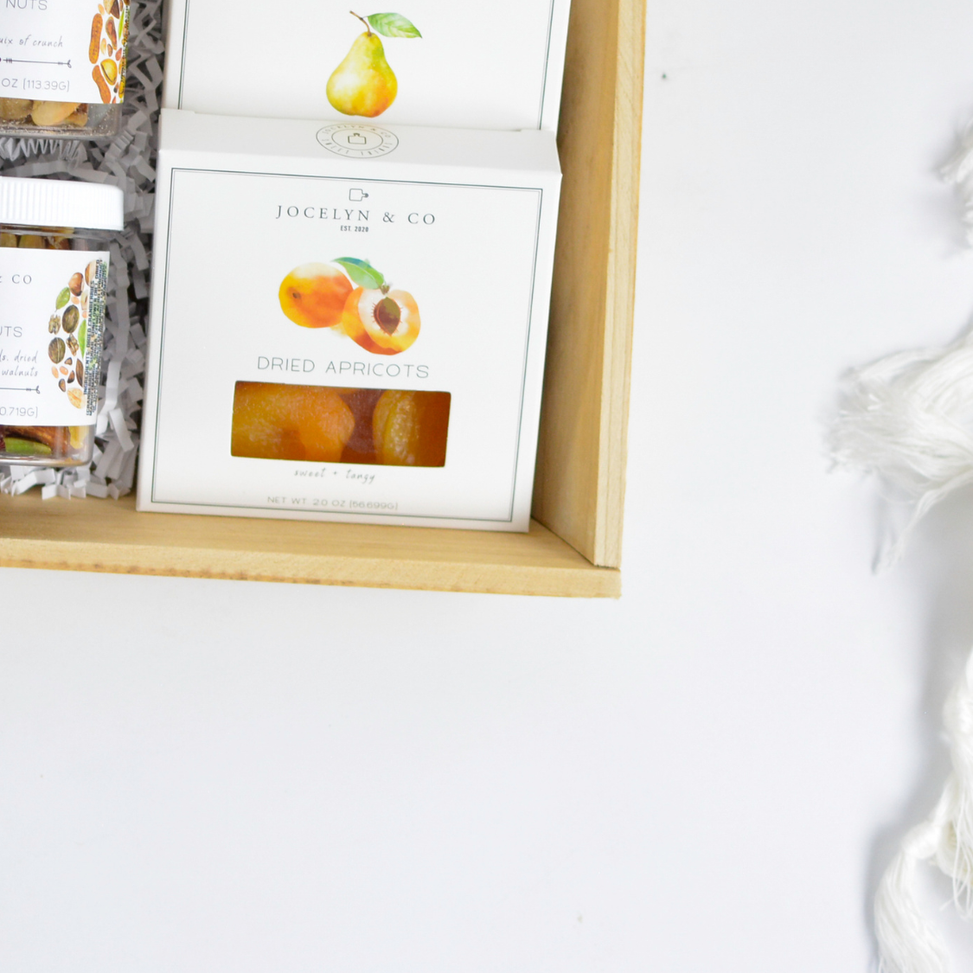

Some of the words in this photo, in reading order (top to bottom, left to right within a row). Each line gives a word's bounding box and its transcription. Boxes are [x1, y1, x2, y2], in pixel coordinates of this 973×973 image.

[19, 34, 31, 45] of
[33, 36, 63, 47] crunch
[1, 78, 18, 88] OZ
[276, 205, 370, 221] JOCELYN
[383, 212, 394, 223] &
[407, 212, 436, 225] CO
[12, 274, 32, 284] CO
[14, 350, 38, 363] dried
[2, 366, 38, 376] walnuts
[257, 356, 315, 373] DRIED
[325, 361, 430, 378] APRICOTS
[294, 467, 326, 477] sweet
[346, 469, 375, 484] tangy
